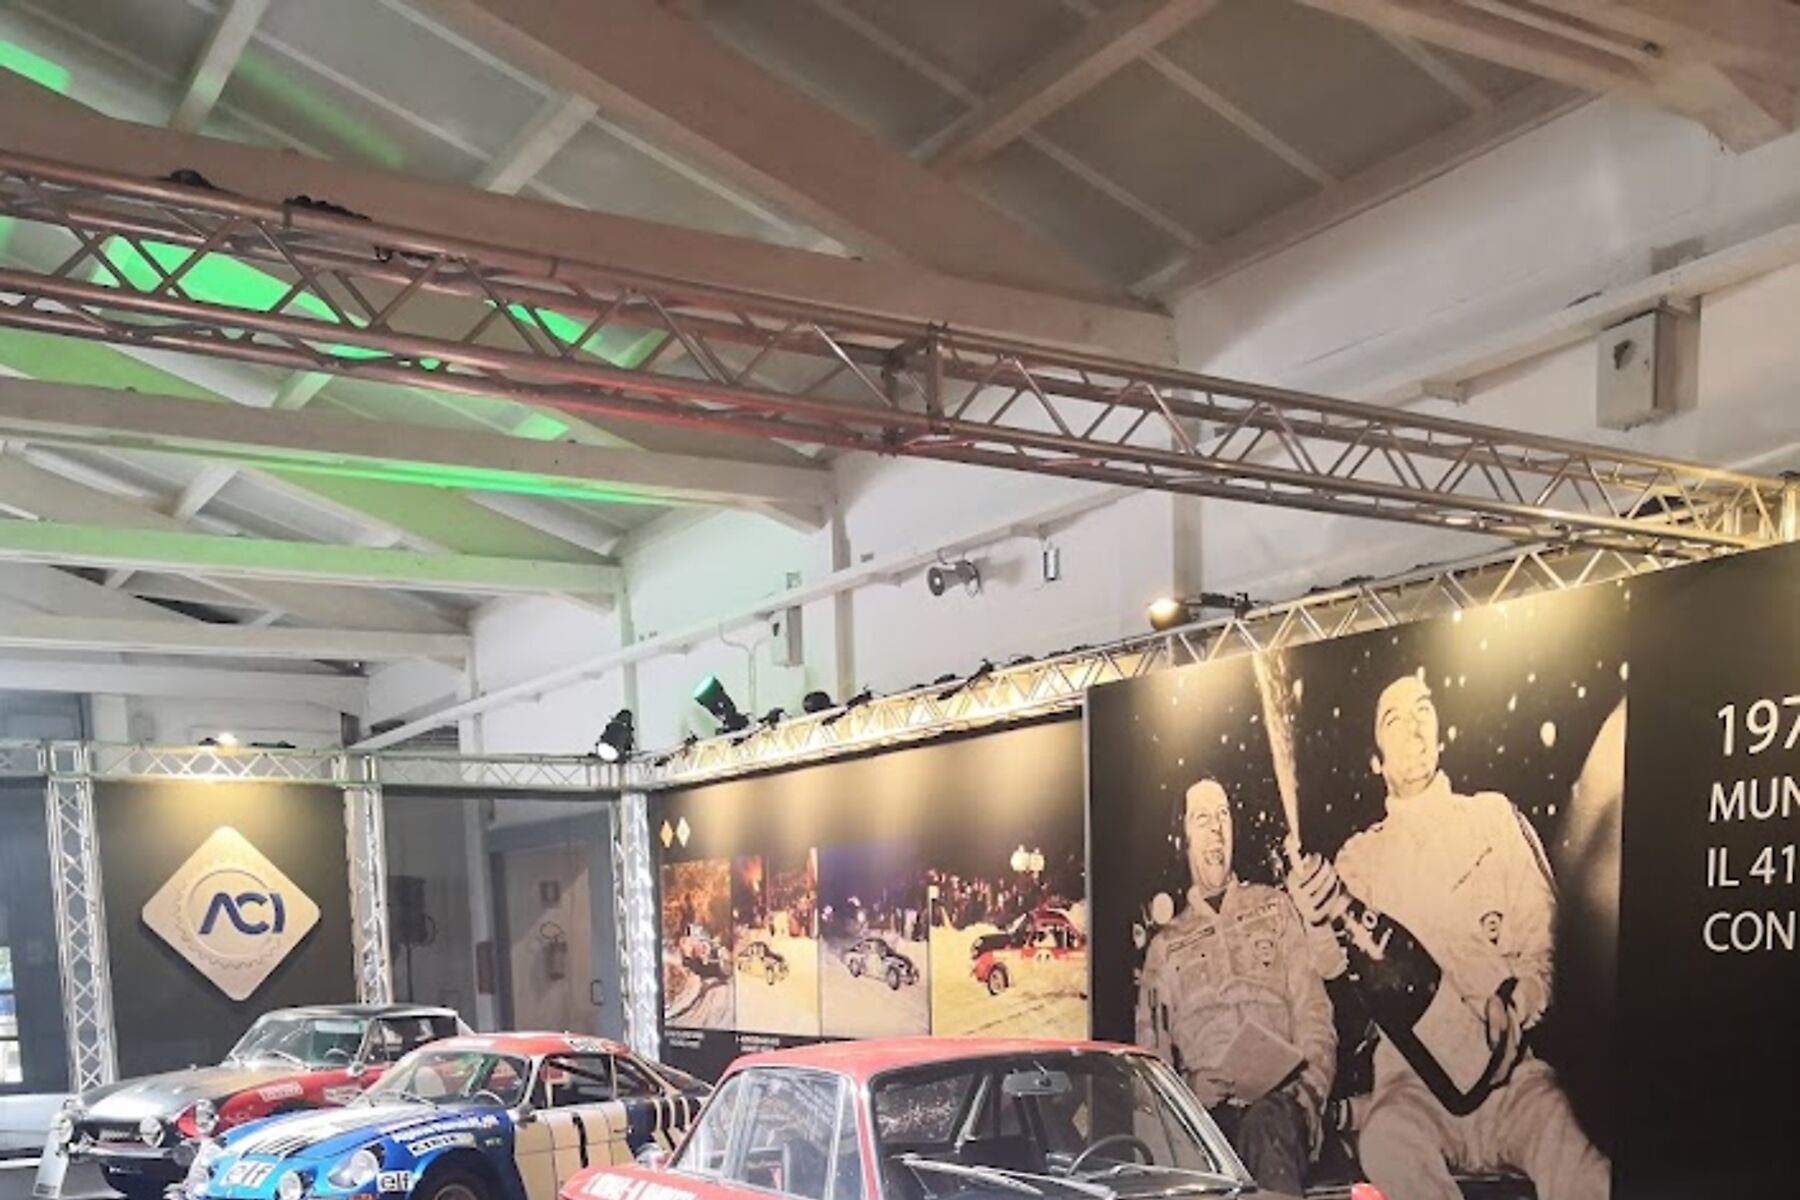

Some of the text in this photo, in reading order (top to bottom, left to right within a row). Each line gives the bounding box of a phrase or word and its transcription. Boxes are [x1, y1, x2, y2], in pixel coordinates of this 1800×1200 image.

[1708, 775, 1800, 823] MUN
[1707, 847, 1740, 888] IL
[199, 892, 286, 935] ACI
[1703, 911, 1796, 952] CON
[226, 1161, 273, 1185] elf
[380, 1172, 409, 1190] elf
